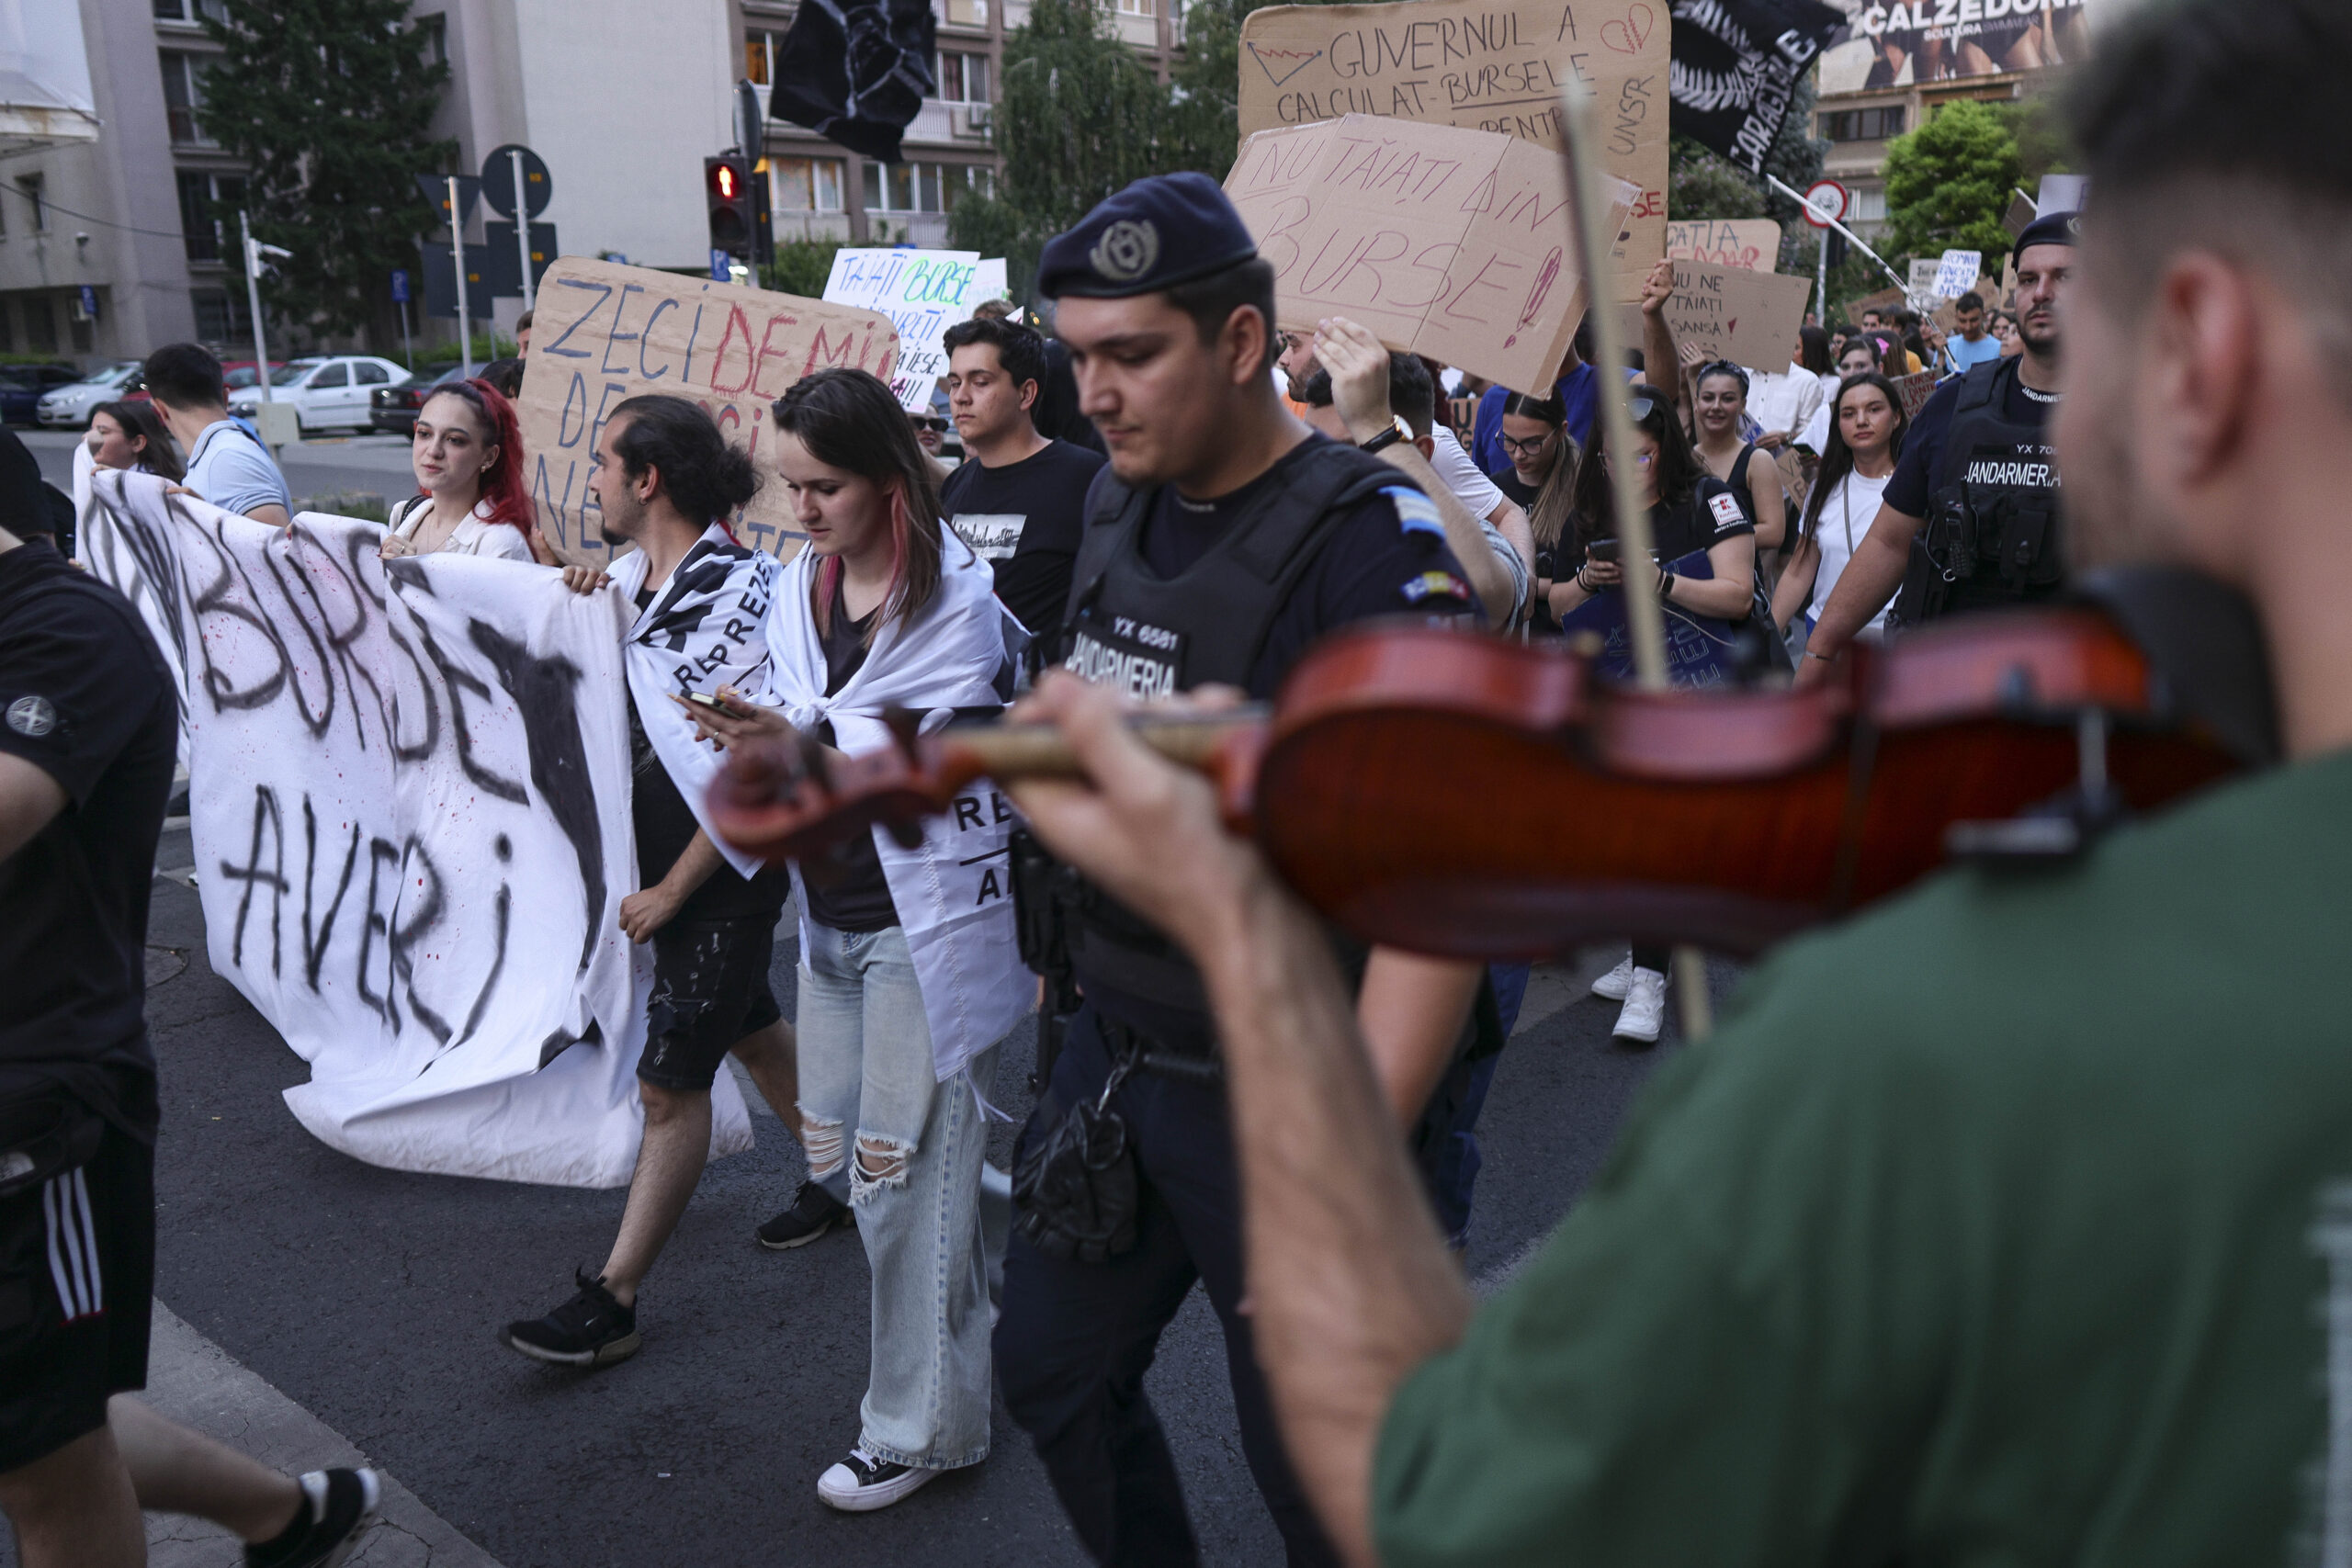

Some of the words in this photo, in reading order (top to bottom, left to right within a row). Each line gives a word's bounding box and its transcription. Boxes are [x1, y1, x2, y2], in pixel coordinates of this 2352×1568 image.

[1329, 11, 1534, 79] GUVERNUL
[1556, 6, 1577, 42] A
[1441, 53, 1597, 105] BURSELE
[1249, 138, 1326, 186] NU
[901, 257, 976, 306] BURSE
[1700, 275, 1724, 293] NE
[543, 278, 708, 383] ZECI
[710, 301, 798, 400] DE
[558, 370, 627, 460] DE
